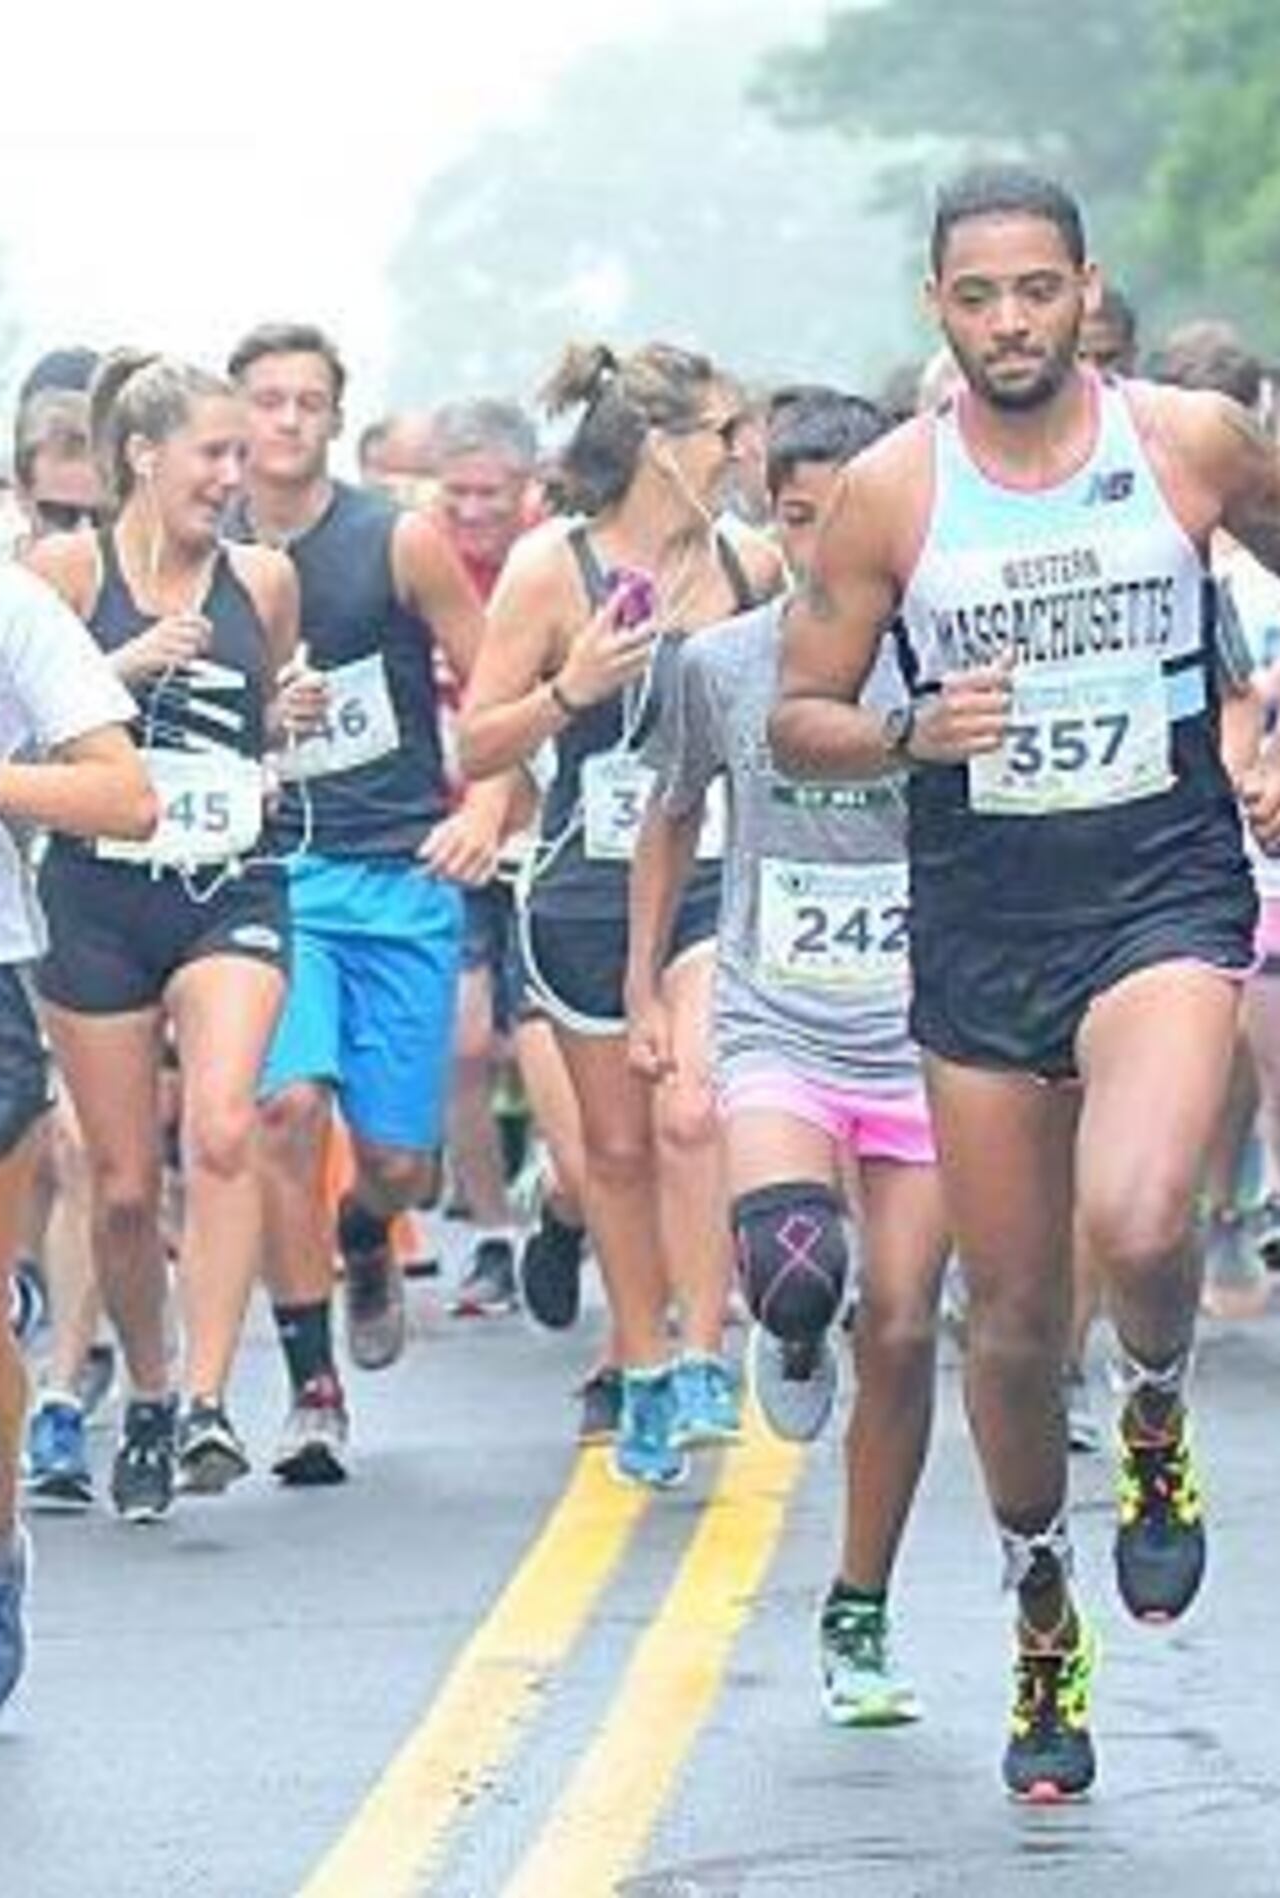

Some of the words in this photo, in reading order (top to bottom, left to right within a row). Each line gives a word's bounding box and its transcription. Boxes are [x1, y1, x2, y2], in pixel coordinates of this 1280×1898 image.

[1003, 549, 1101, 588] WESTERN
[929, 576, 1174, 668] MASSACHUSETTS
[1004, 714, 1132, 775] 357
[791, 906, 911, 953] 242
